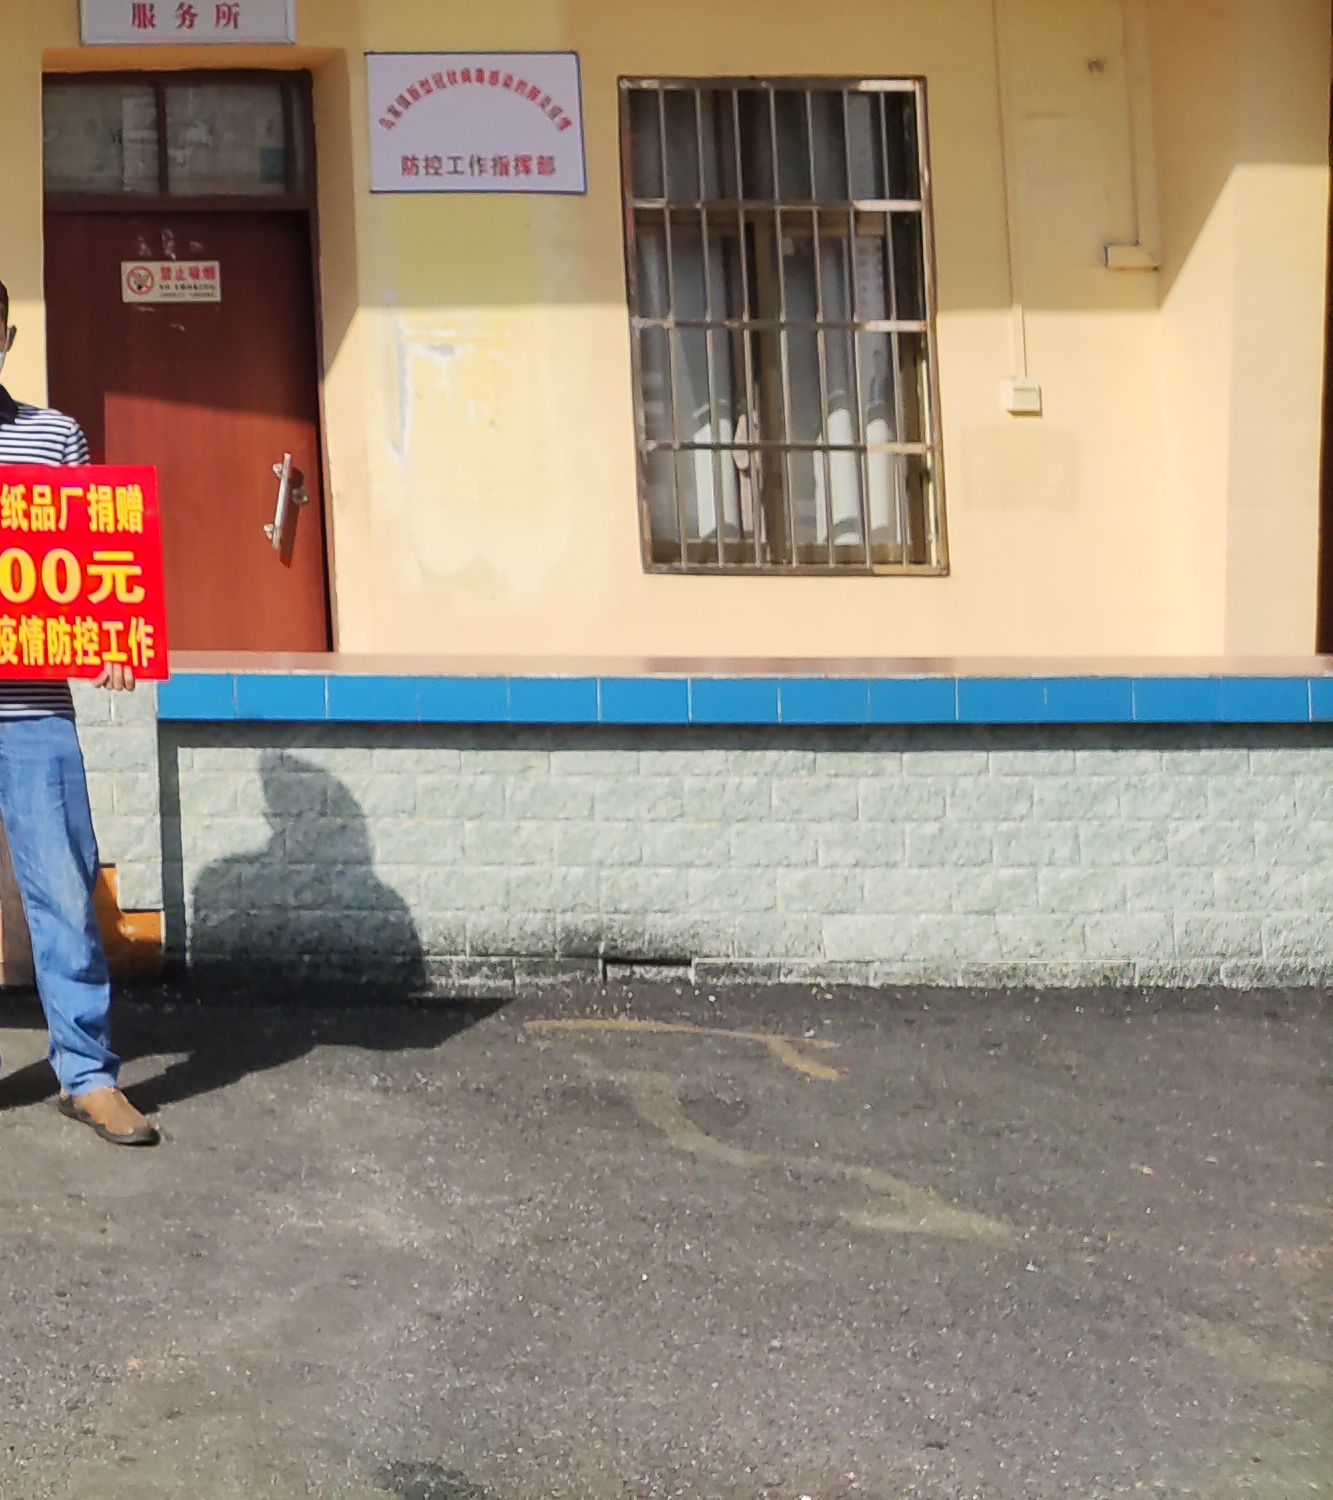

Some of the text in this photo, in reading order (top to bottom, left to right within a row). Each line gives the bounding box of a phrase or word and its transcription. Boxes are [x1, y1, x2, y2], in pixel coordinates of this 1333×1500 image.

[131, 1, 241, 31] 服务所
[399, 154, 557, 177] 防控工作指挥部
